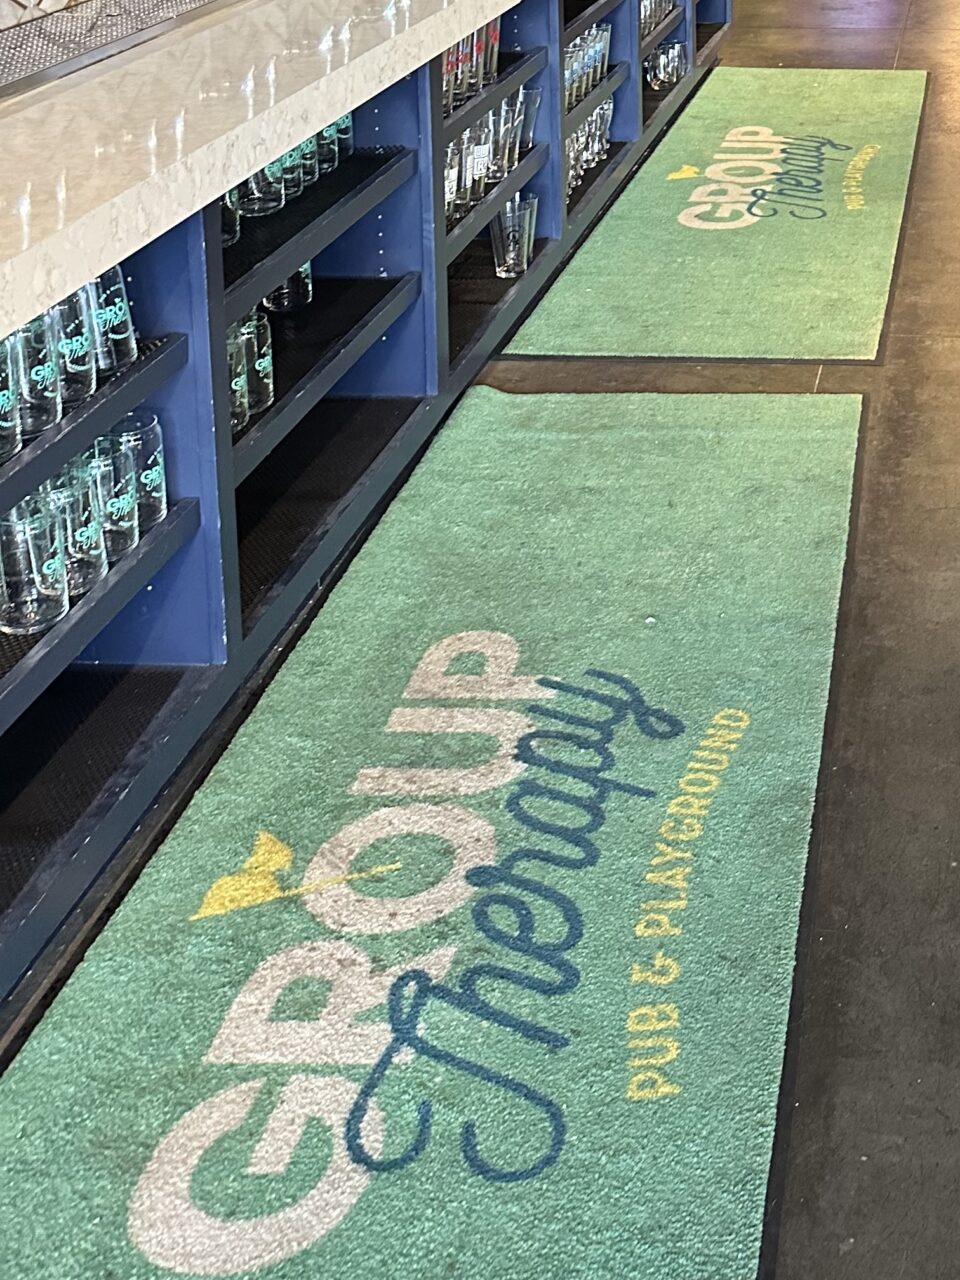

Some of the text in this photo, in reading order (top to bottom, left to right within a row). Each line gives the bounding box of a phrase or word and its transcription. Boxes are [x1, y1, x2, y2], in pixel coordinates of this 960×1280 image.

[677, 125, 796, 230] GROUP
[746, 134, 853, 220] Therapy
[125, 629, 558, 1276] GROUP
[344, 668, 687, 1184] Therapy
[625, 706, 752, 1102] PUB & PLAYGROUND
